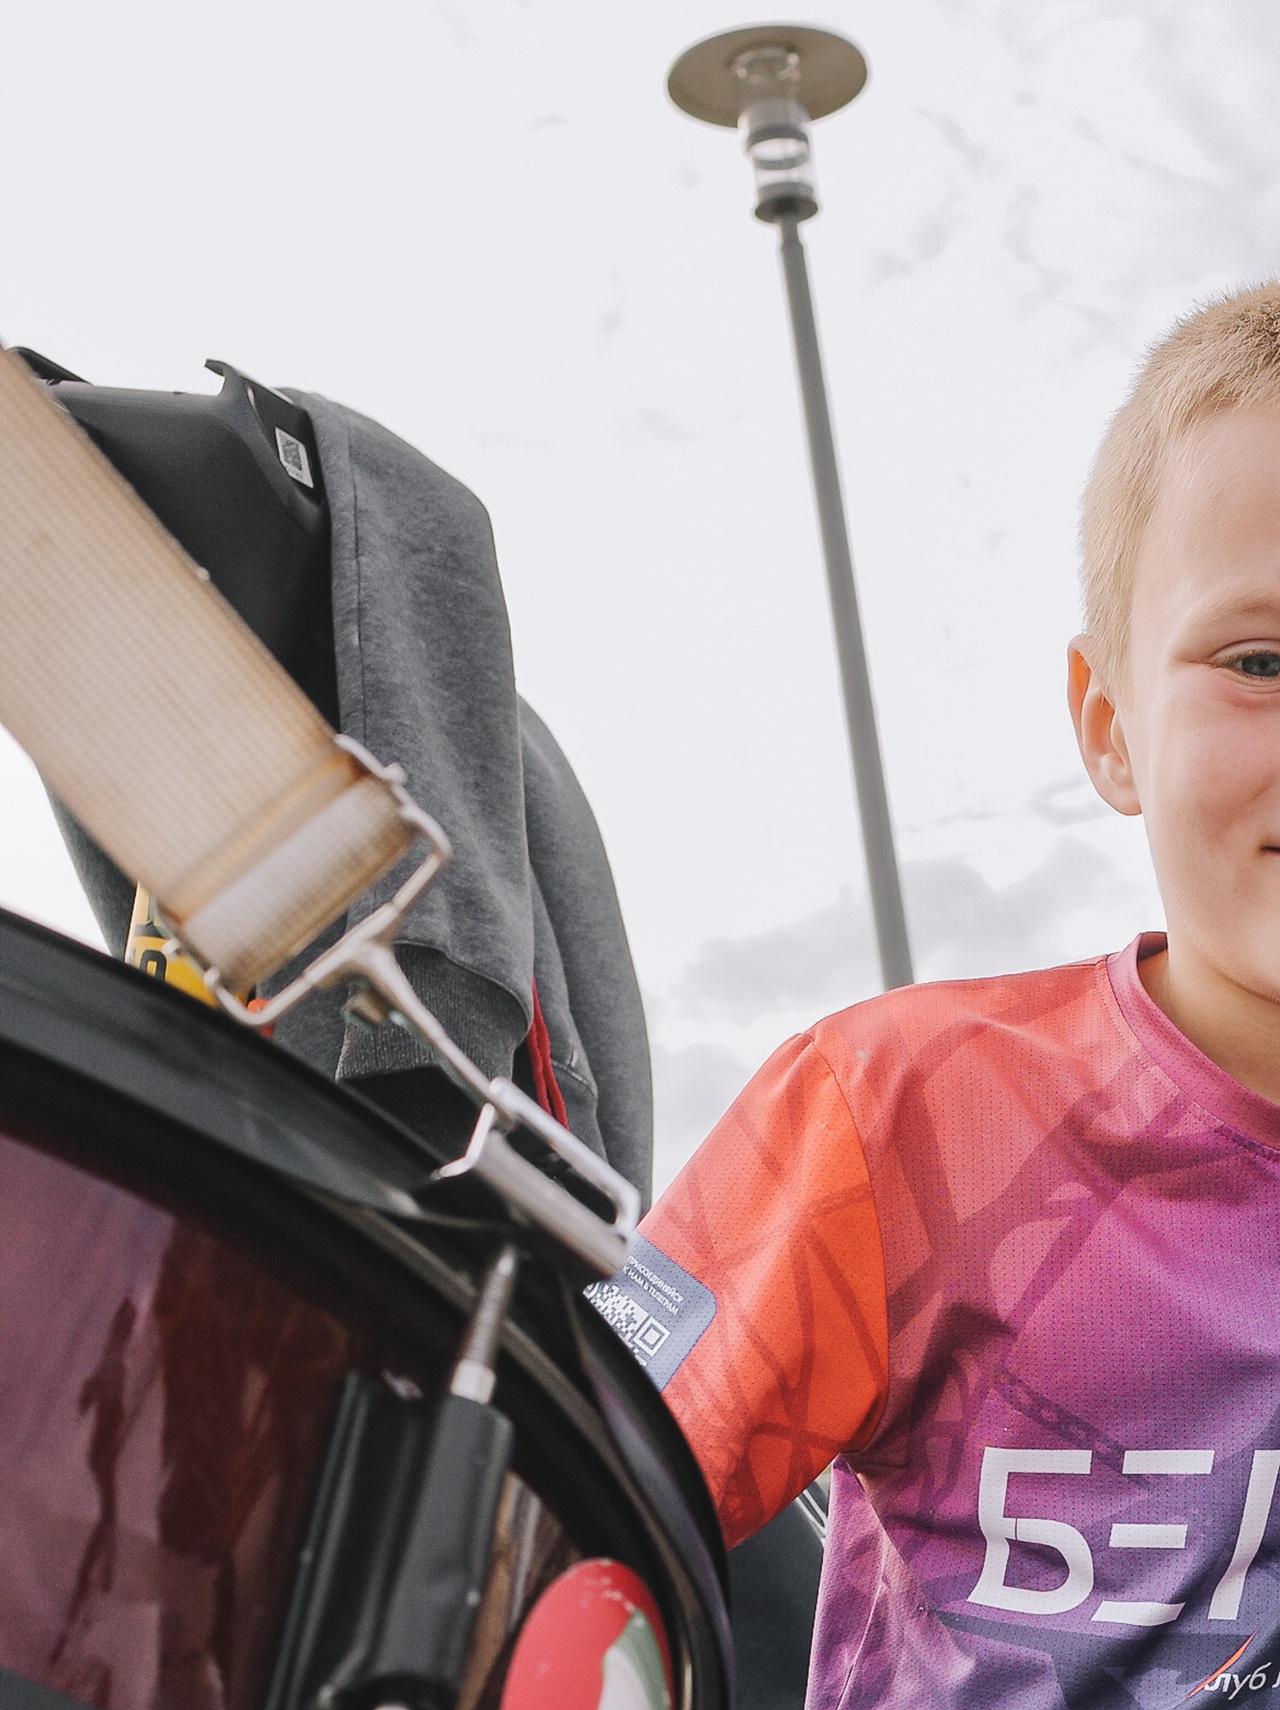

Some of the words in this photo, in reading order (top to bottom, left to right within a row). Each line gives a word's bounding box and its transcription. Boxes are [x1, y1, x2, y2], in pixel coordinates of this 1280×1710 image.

[627, 1269, 645, 1287] НАМ
[648, 1286, 679, 1315] ТЕЛЕГРАМ
[1203, 1661, 1272, 1701] луб
